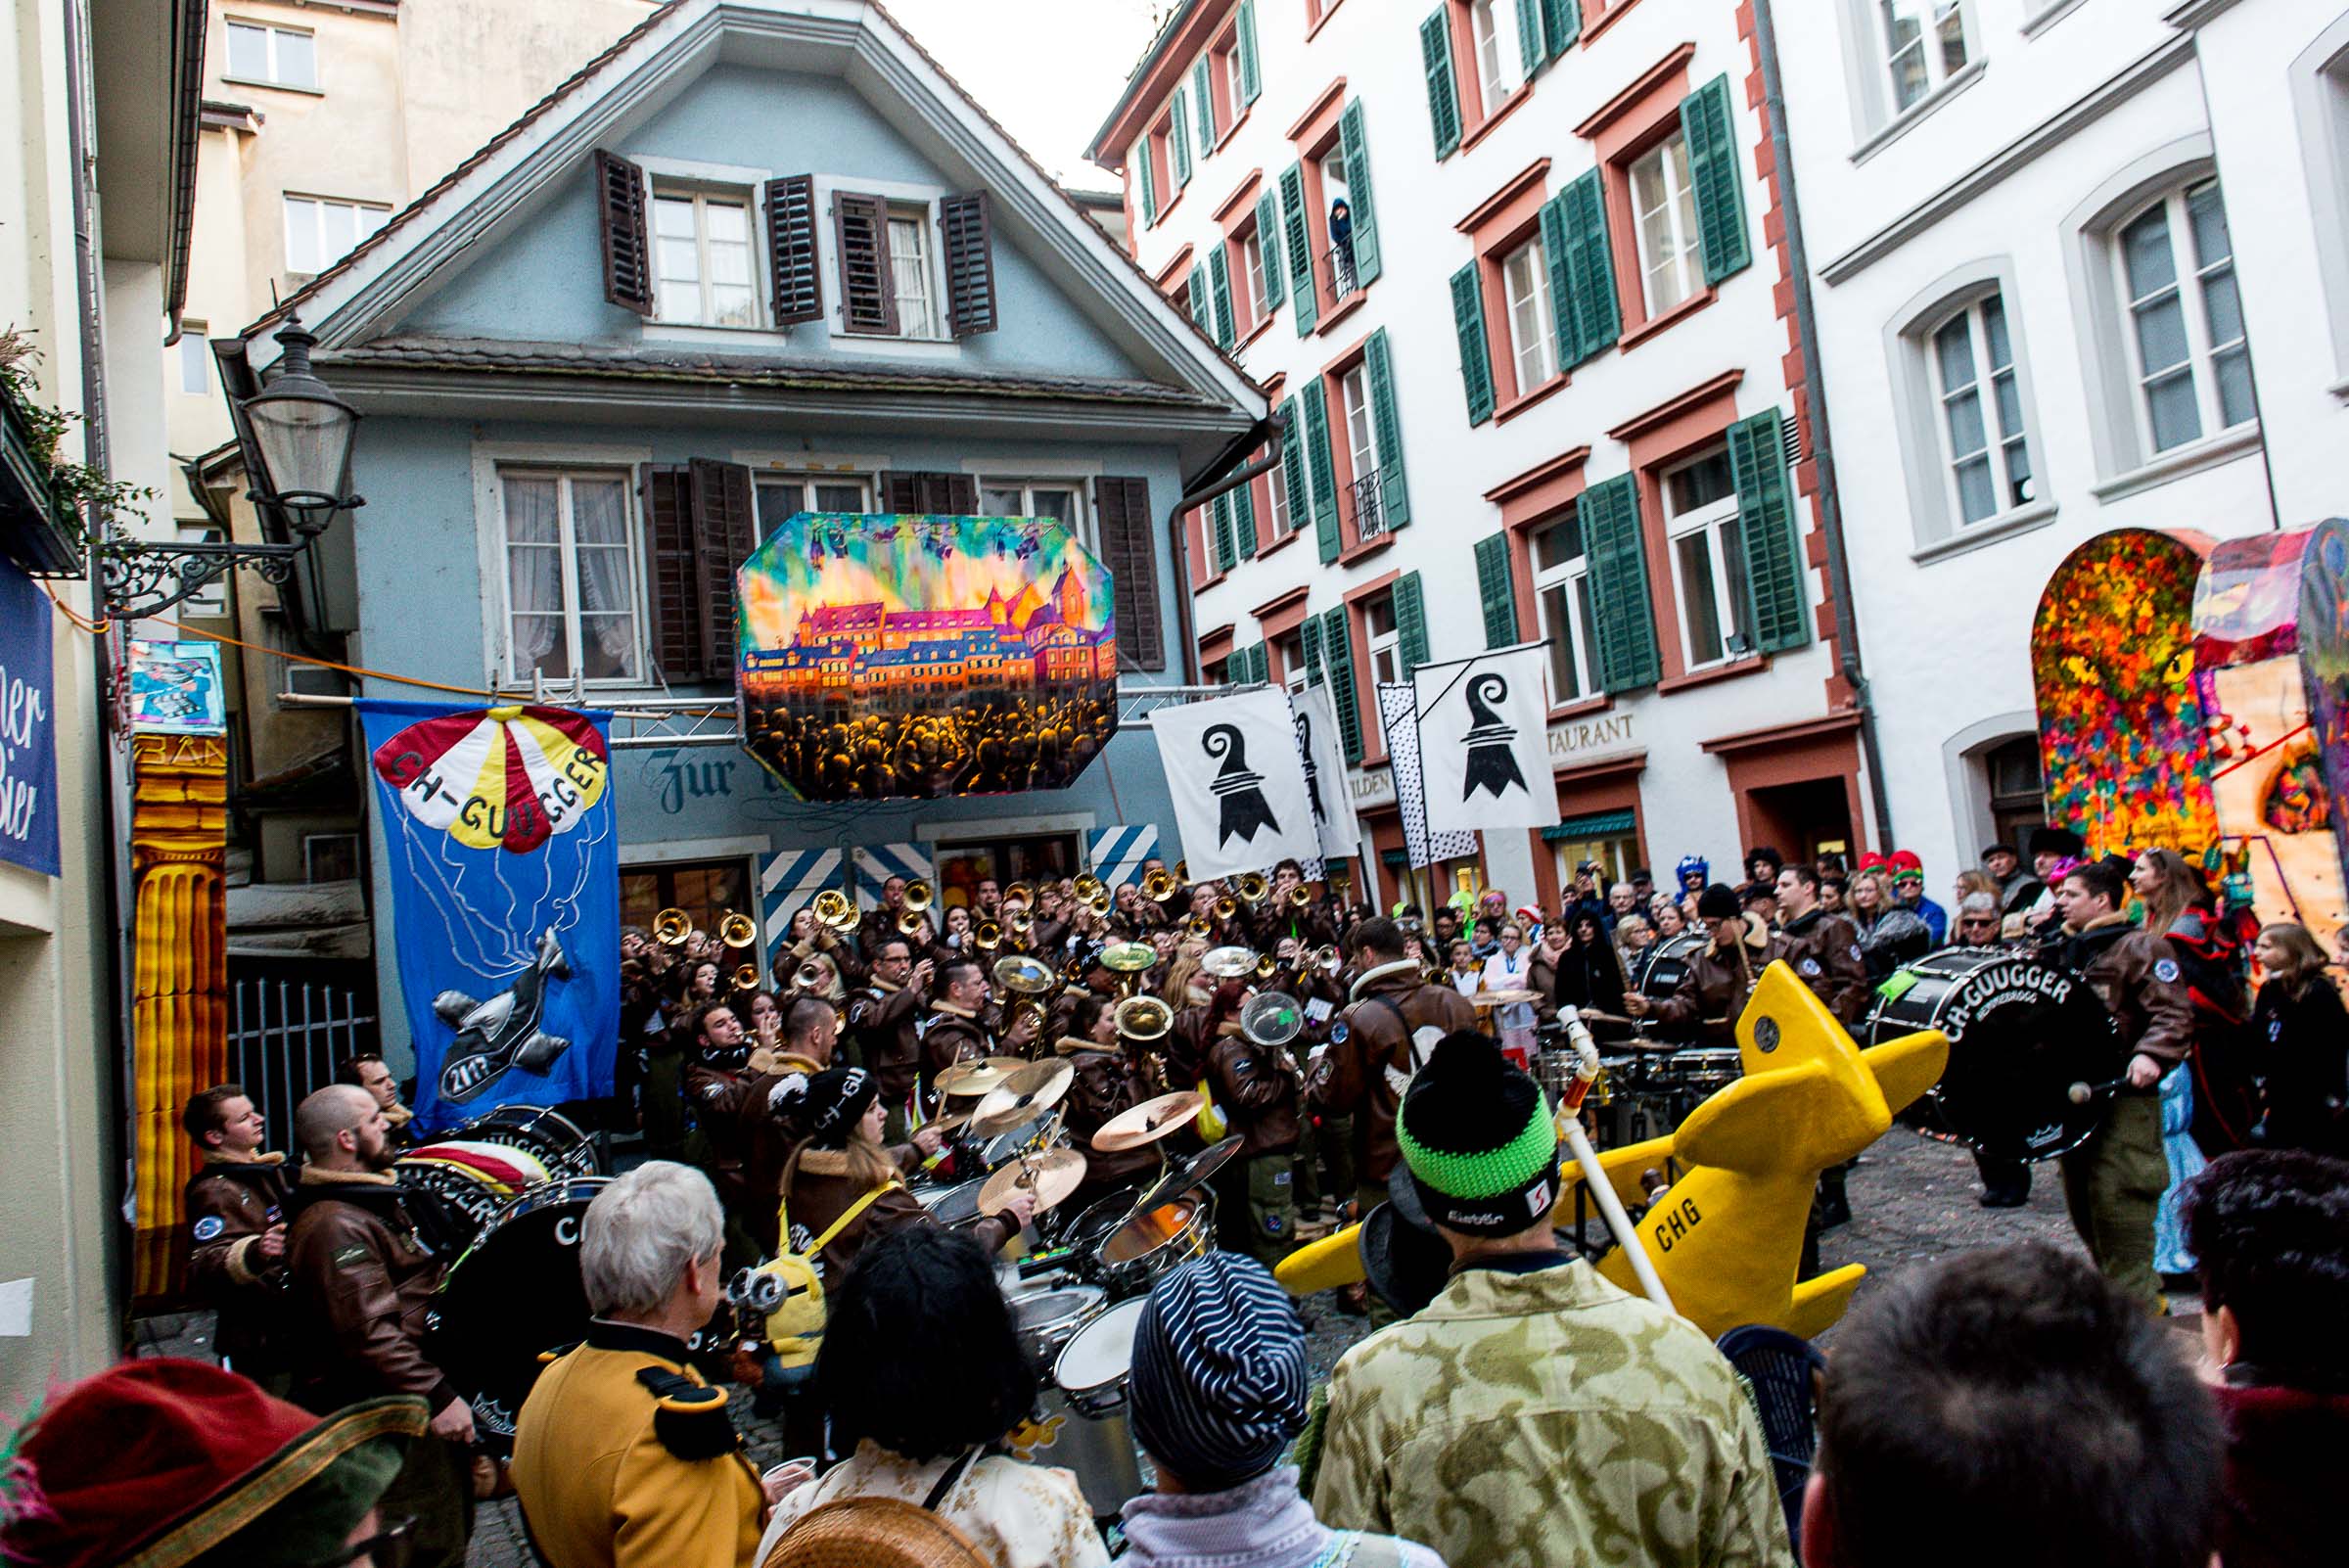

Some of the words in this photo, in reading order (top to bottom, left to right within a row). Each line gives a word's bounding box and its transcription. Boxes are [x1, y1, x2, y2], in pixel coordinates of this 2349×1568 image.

[392, 748, 603, 838] CH-GUUGGER
[1942, 963, 2072, 1043] CH-GUUGGER
[1654, 1197, 1701, 1253] CHG
